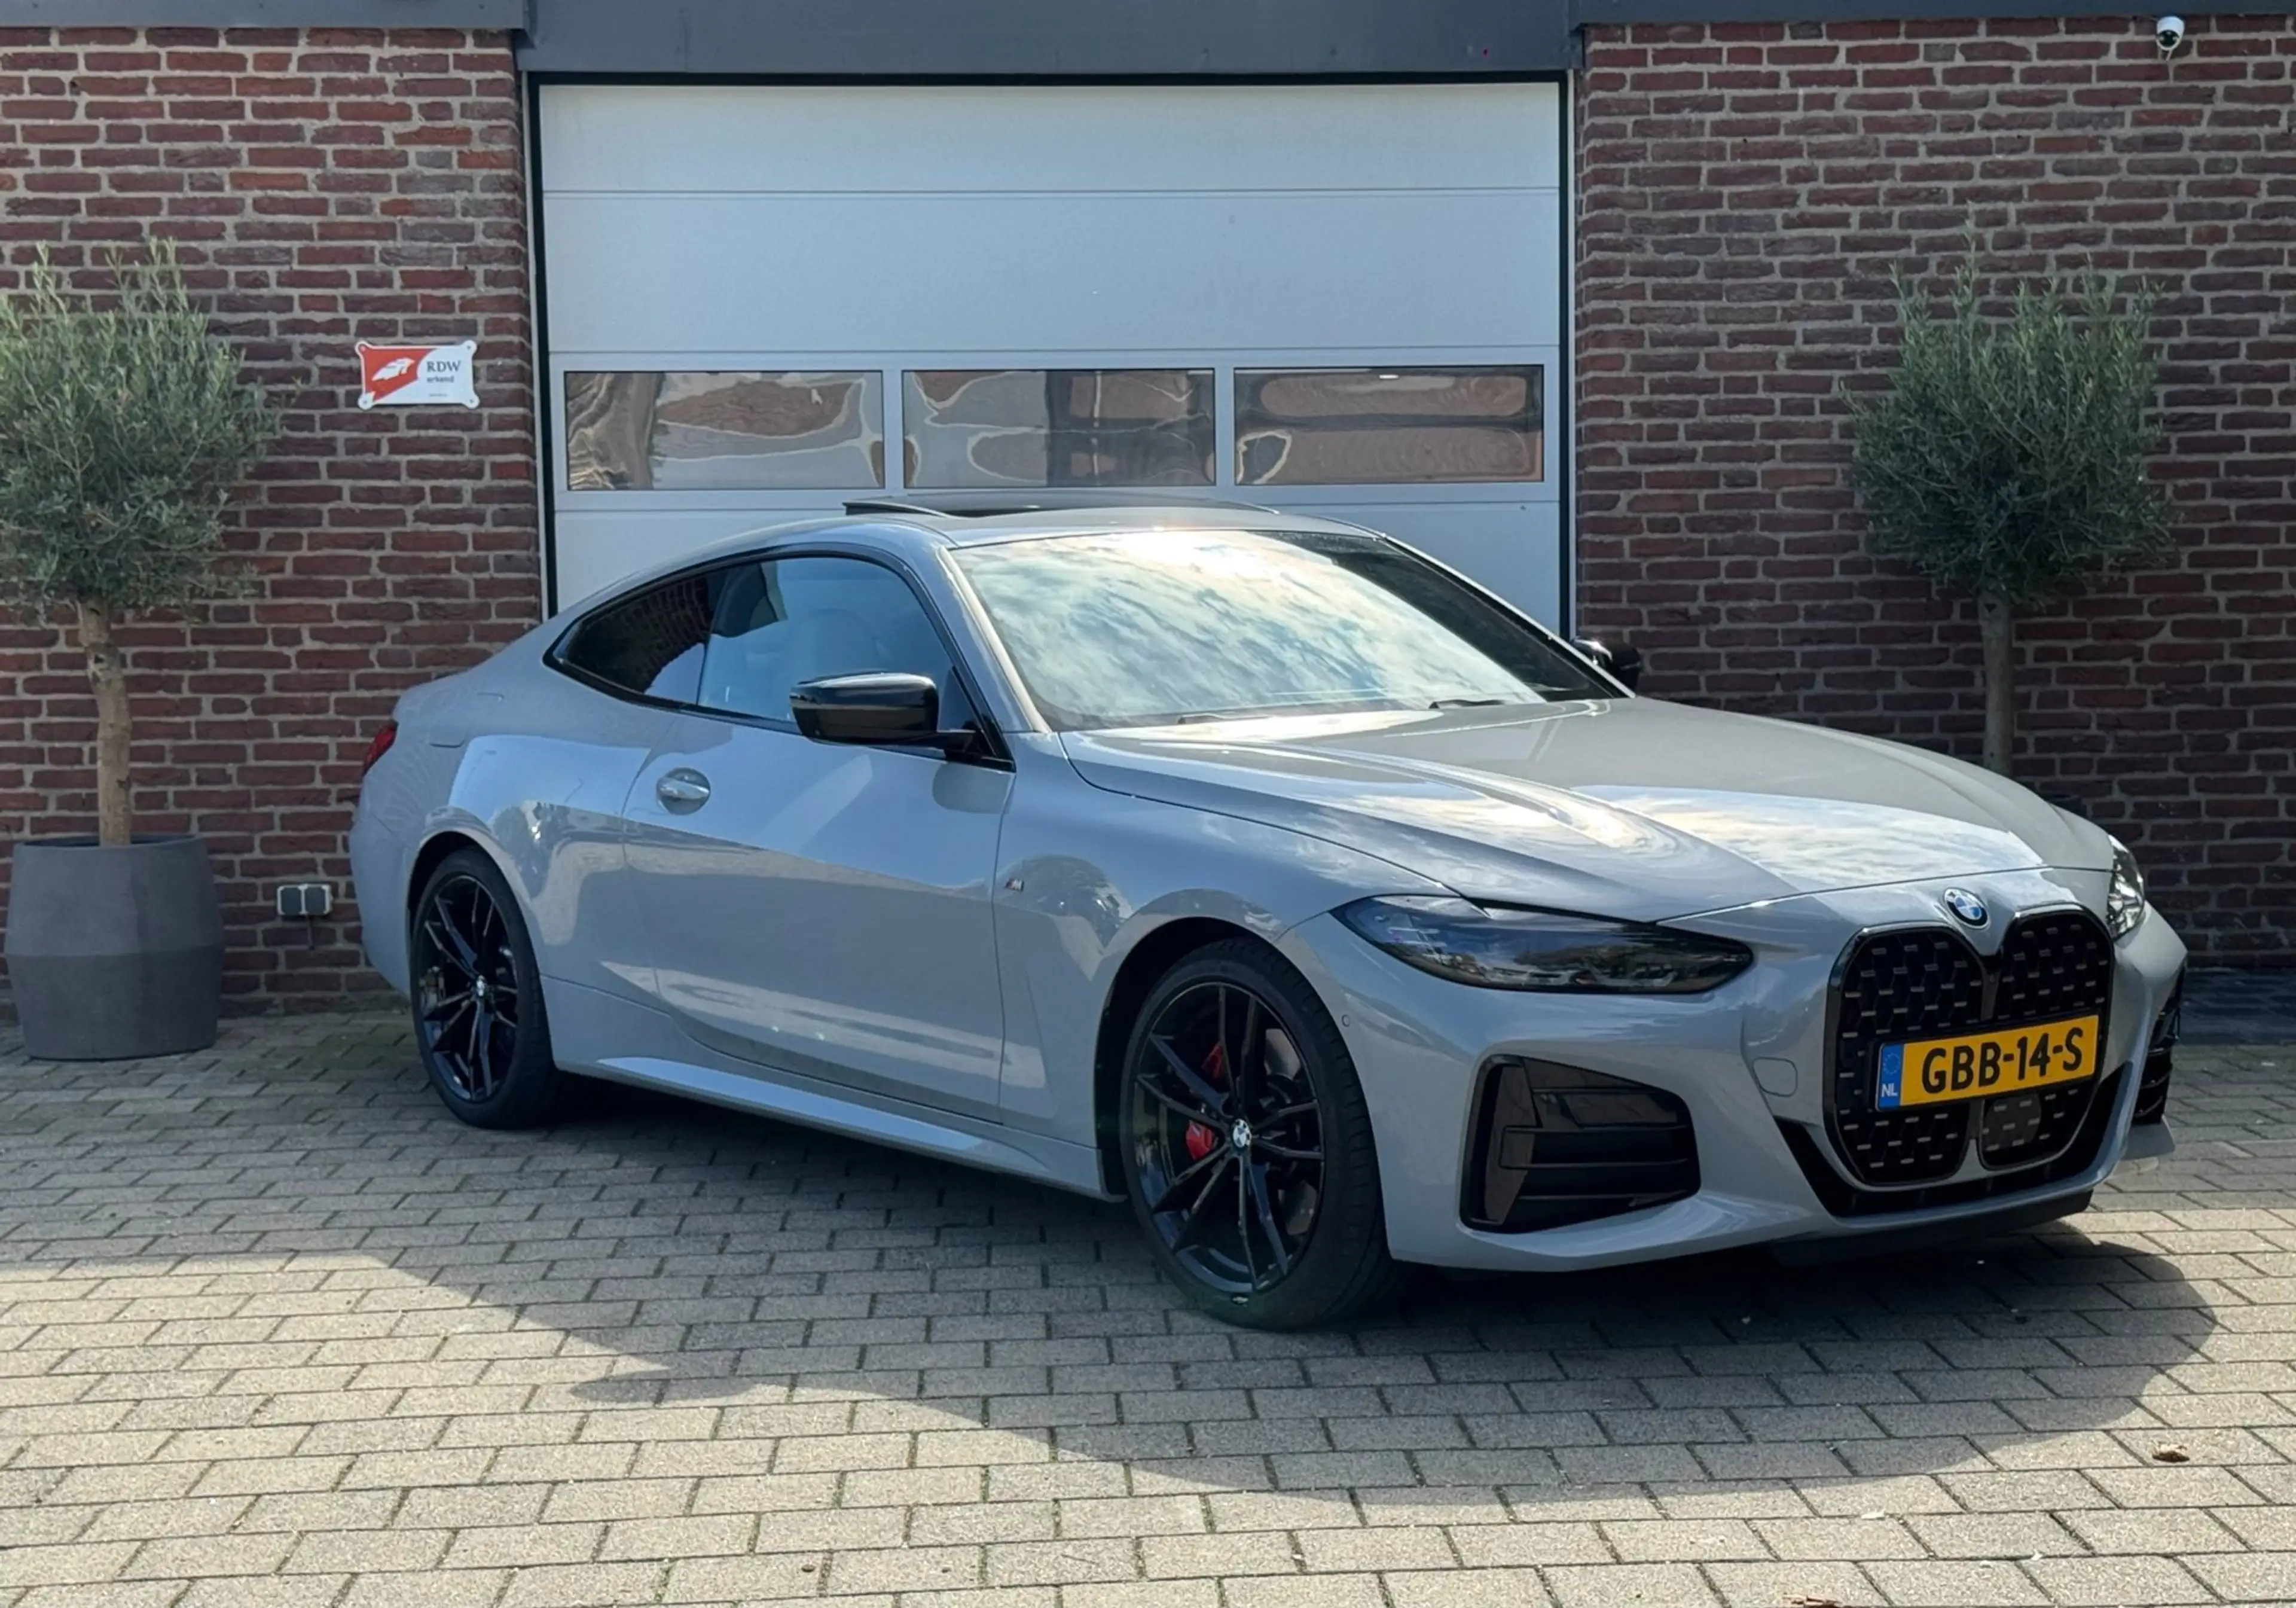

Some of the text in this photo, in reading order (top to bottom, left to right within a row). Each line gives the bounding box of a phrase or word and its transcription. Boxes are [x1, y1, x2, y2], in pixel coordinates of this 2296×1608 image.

[427, 361, 461, 372] RDW
[1922, 1027, 2084, 1094] GBB-14-S
[1881, 1083, 1898, 1098] NL
